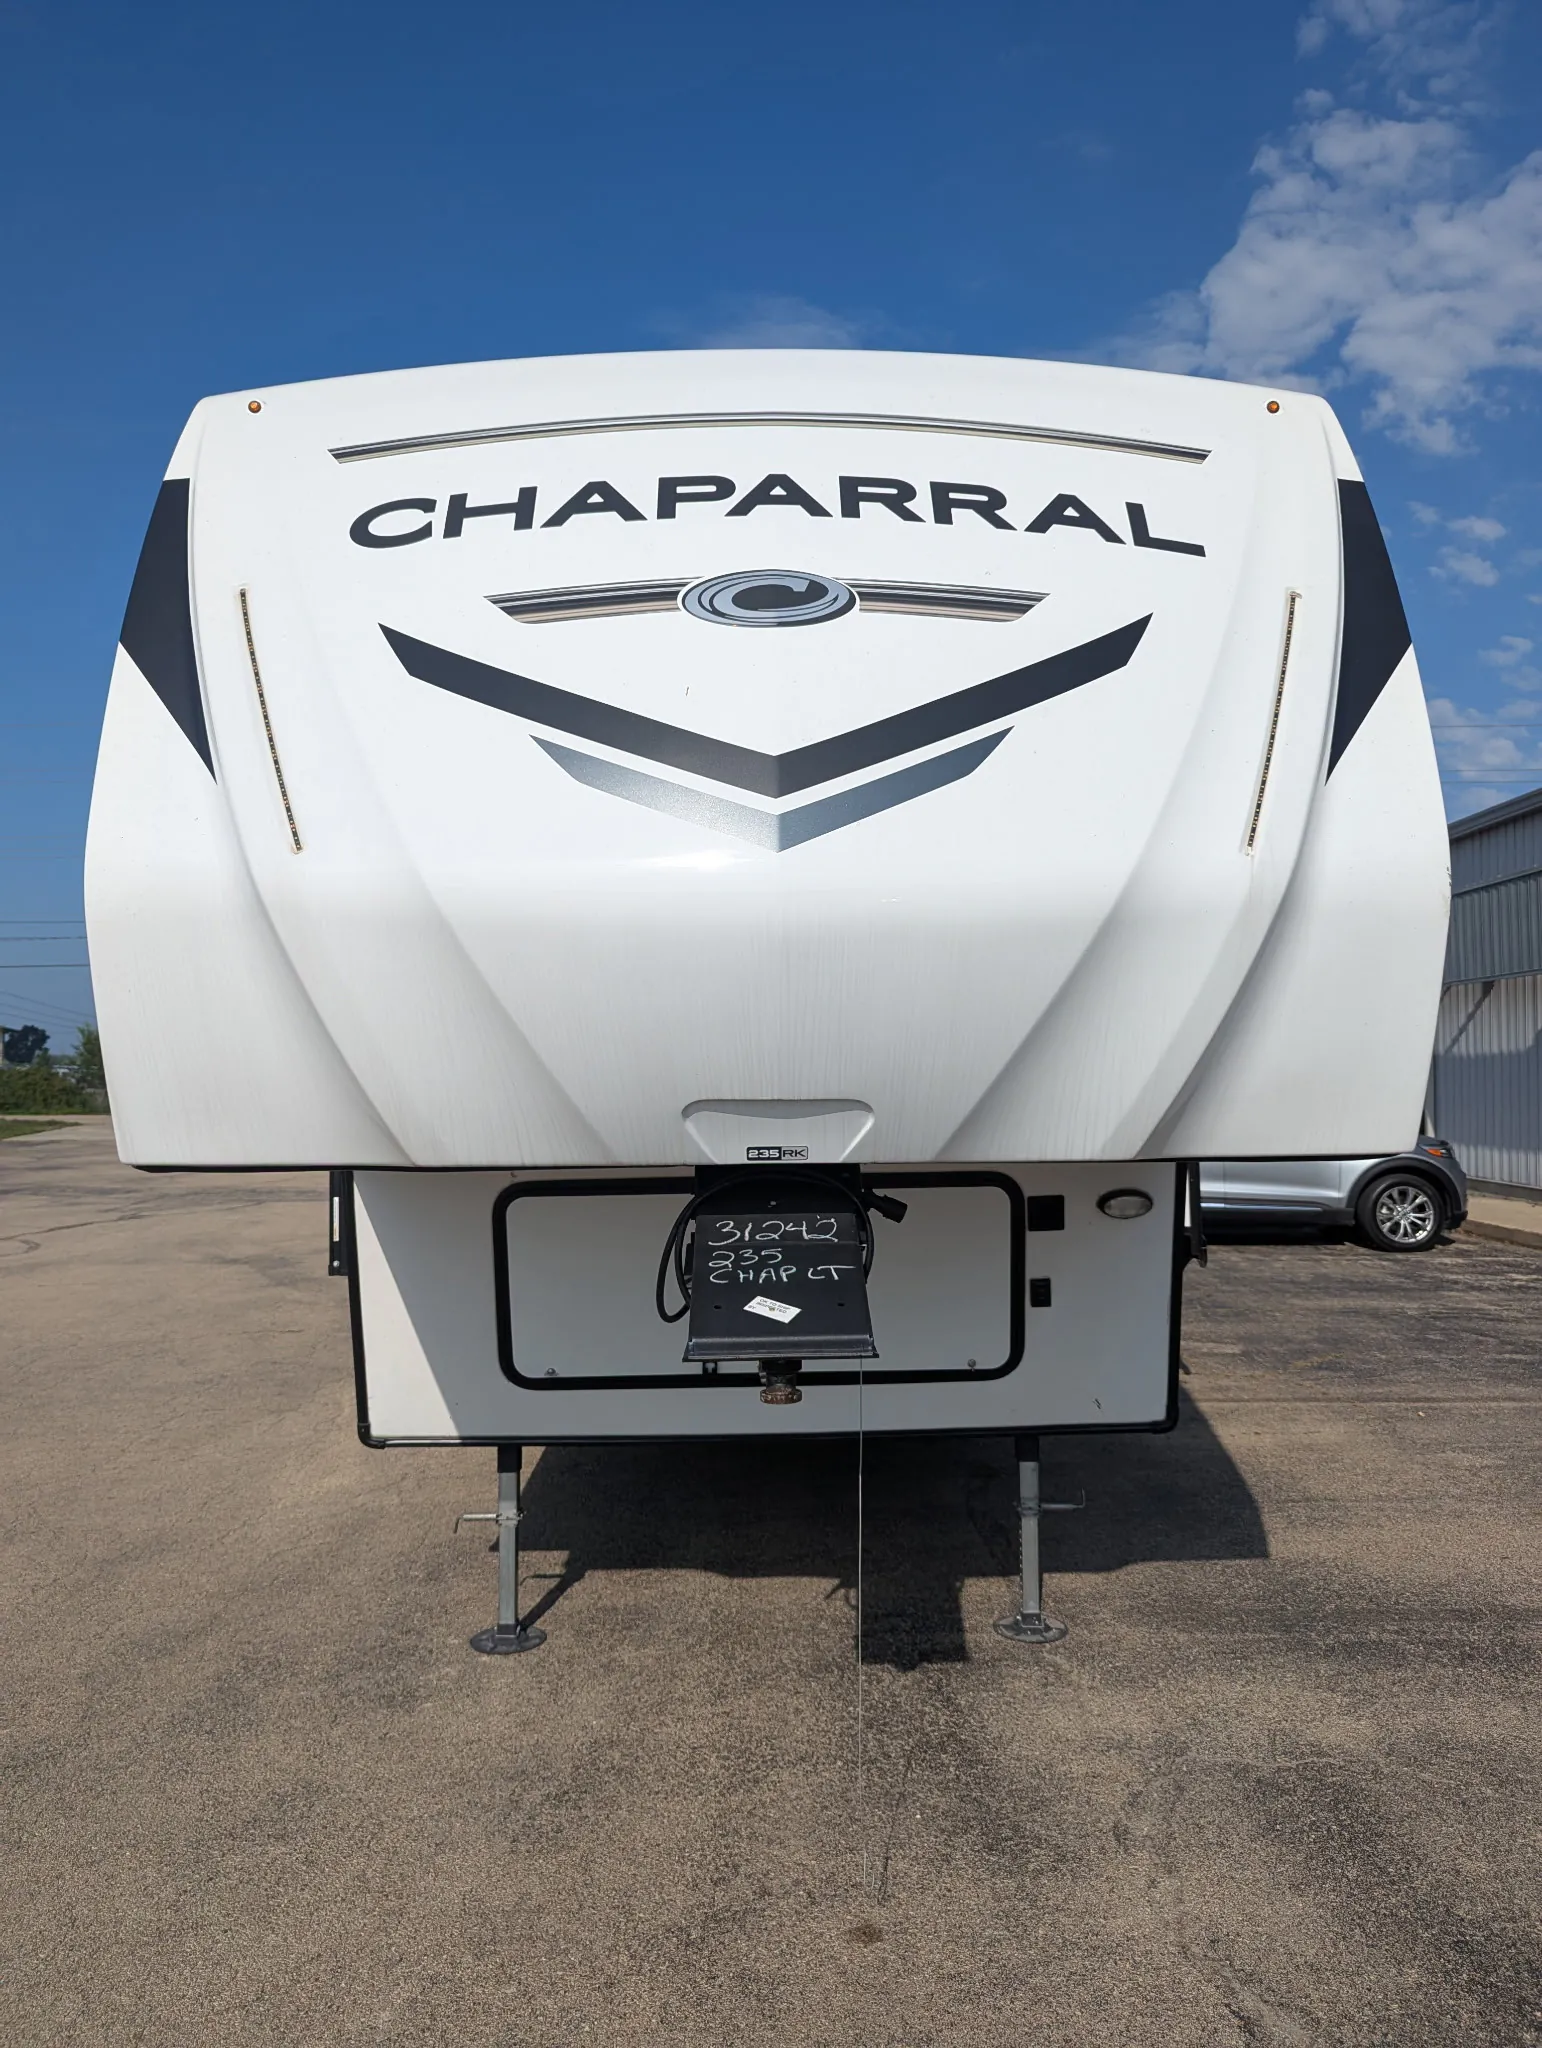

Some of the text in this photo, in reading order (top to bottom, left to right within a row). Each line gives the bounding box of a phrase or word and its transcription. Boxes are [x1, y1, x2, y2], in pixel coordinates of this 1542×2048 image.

[349, 473, 1206, 558] CHAPARRAL
[708, 1217, 838, 1246] 31242
[708, 1248, 782, 1268] 235
[709, 1265, 797, 1284] CHAP
